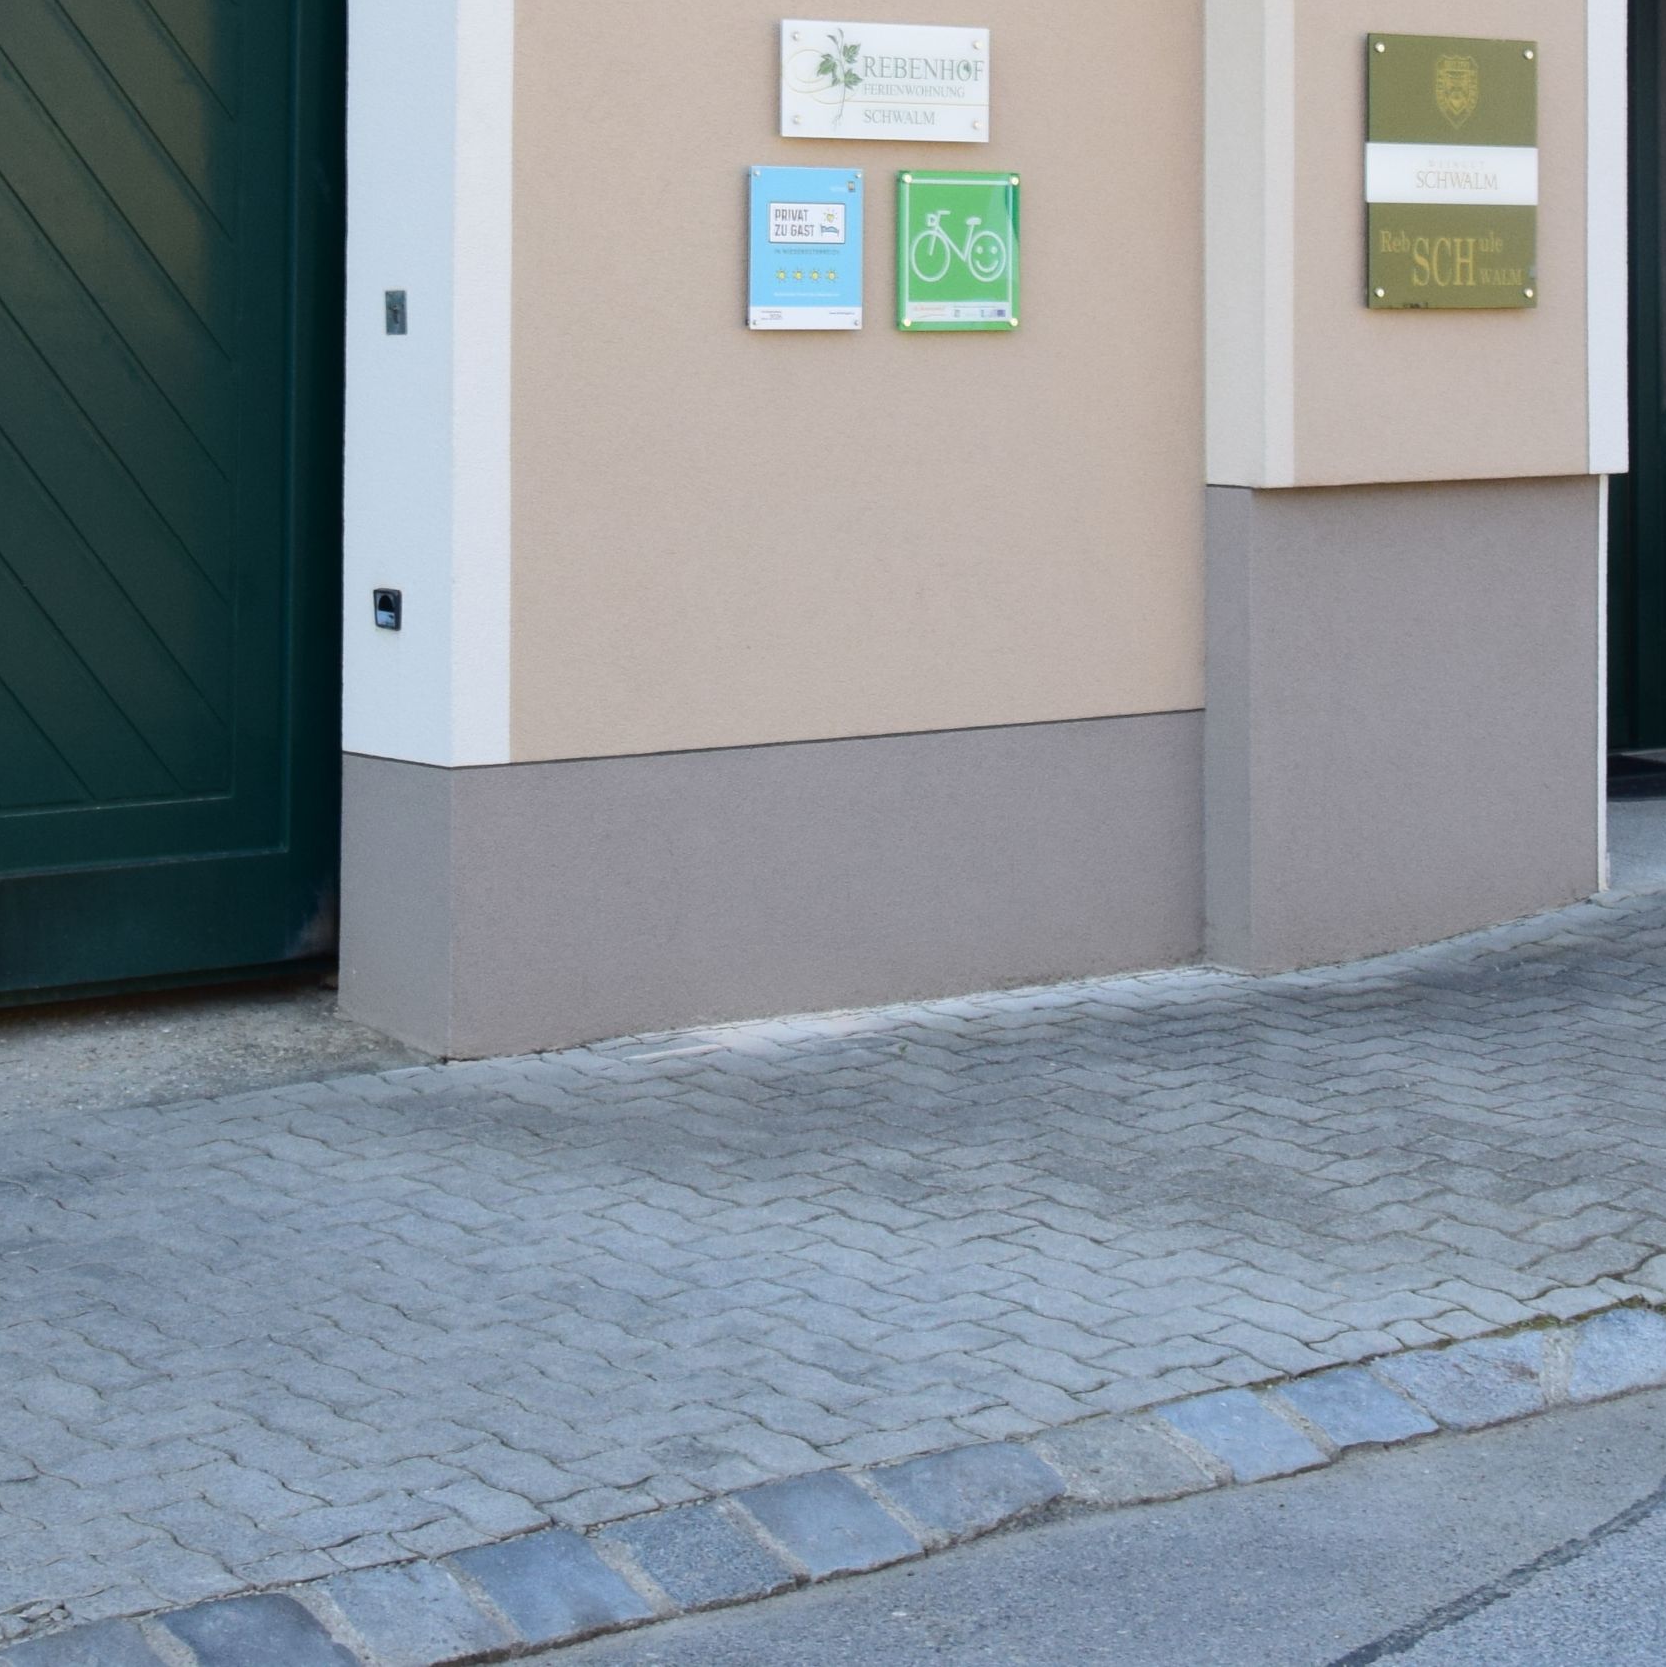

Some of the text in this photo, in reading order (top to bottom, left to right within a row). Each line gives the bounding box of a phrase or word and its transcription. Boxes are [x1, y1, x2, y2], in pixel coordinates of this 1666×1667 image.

[862, 55, 985, 82] REBENHOF
[863, 84, 965, 98] FERIENWOHNUNG
[863, 109, 935, 125] SCHWALM
[1415, 171, 1498, 191] SCHWALM
[774, 208, 809, 222] PRIVAT
[774, 224, 815, 237] ZU GAST
